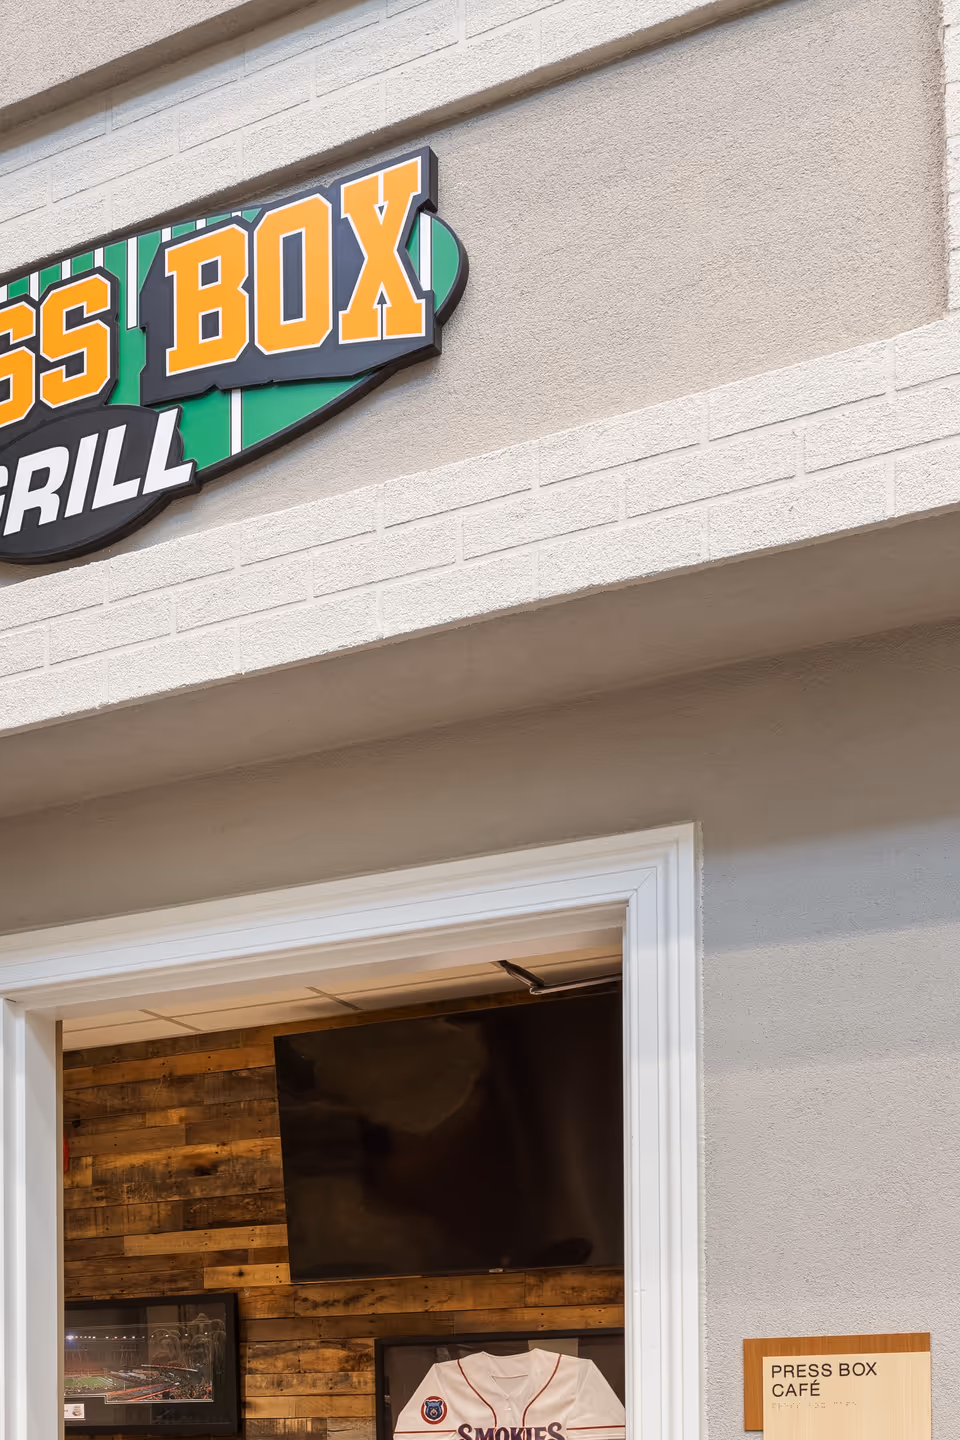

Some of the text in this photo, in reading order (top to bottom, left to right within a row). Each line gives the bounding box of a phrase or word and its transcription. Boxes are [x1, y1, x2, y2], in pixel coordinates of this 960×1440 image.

[165, 155, 426, 377] BOX
[771, 1361, 878, 1378] PRESS BOX
[771, 1379, 821, 1397] CAFÉ
